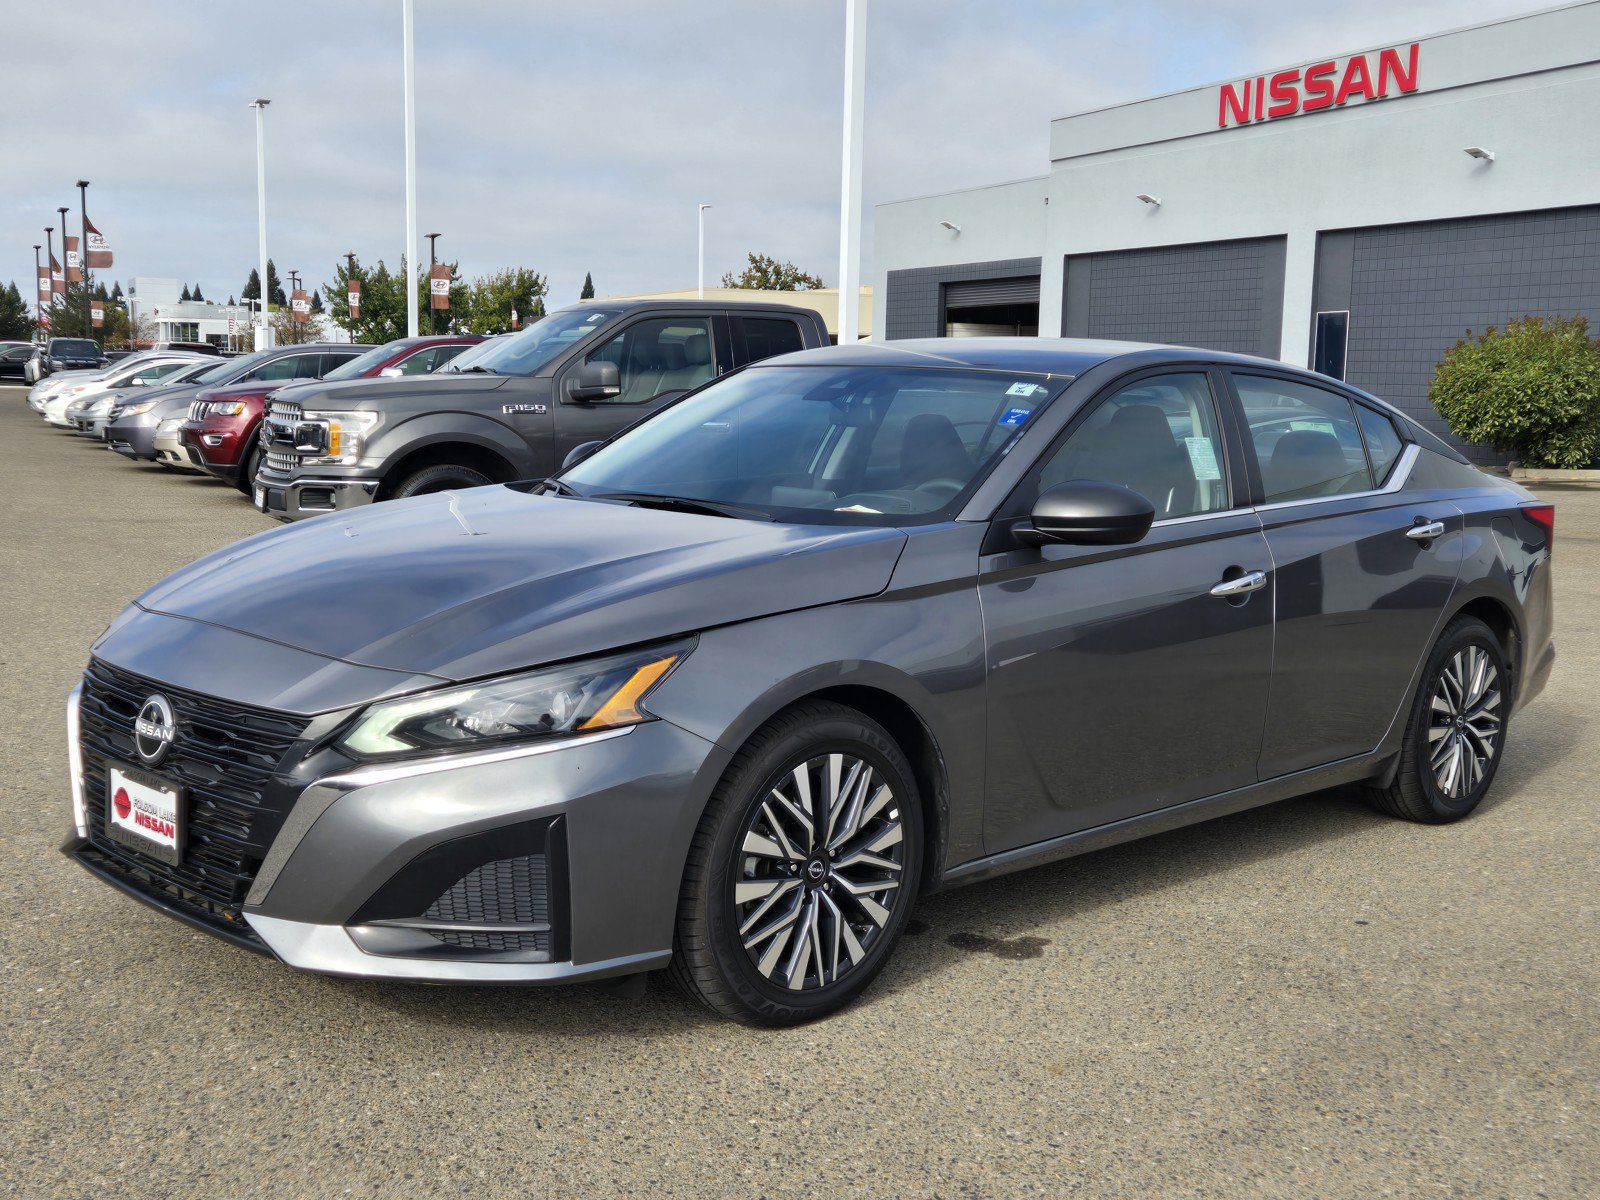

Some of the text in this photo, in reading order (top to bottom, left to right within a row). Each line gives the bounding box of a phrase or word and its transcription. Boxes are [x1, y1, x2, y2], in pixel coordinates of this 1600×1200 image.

[1218, 43, 1421, 128] NISSAN
[135, 720, 173, 741] NISSAN
[133, 797, 176, 823] FOLSOM LAKE
[134, 810, 175, 839] NISSAN
